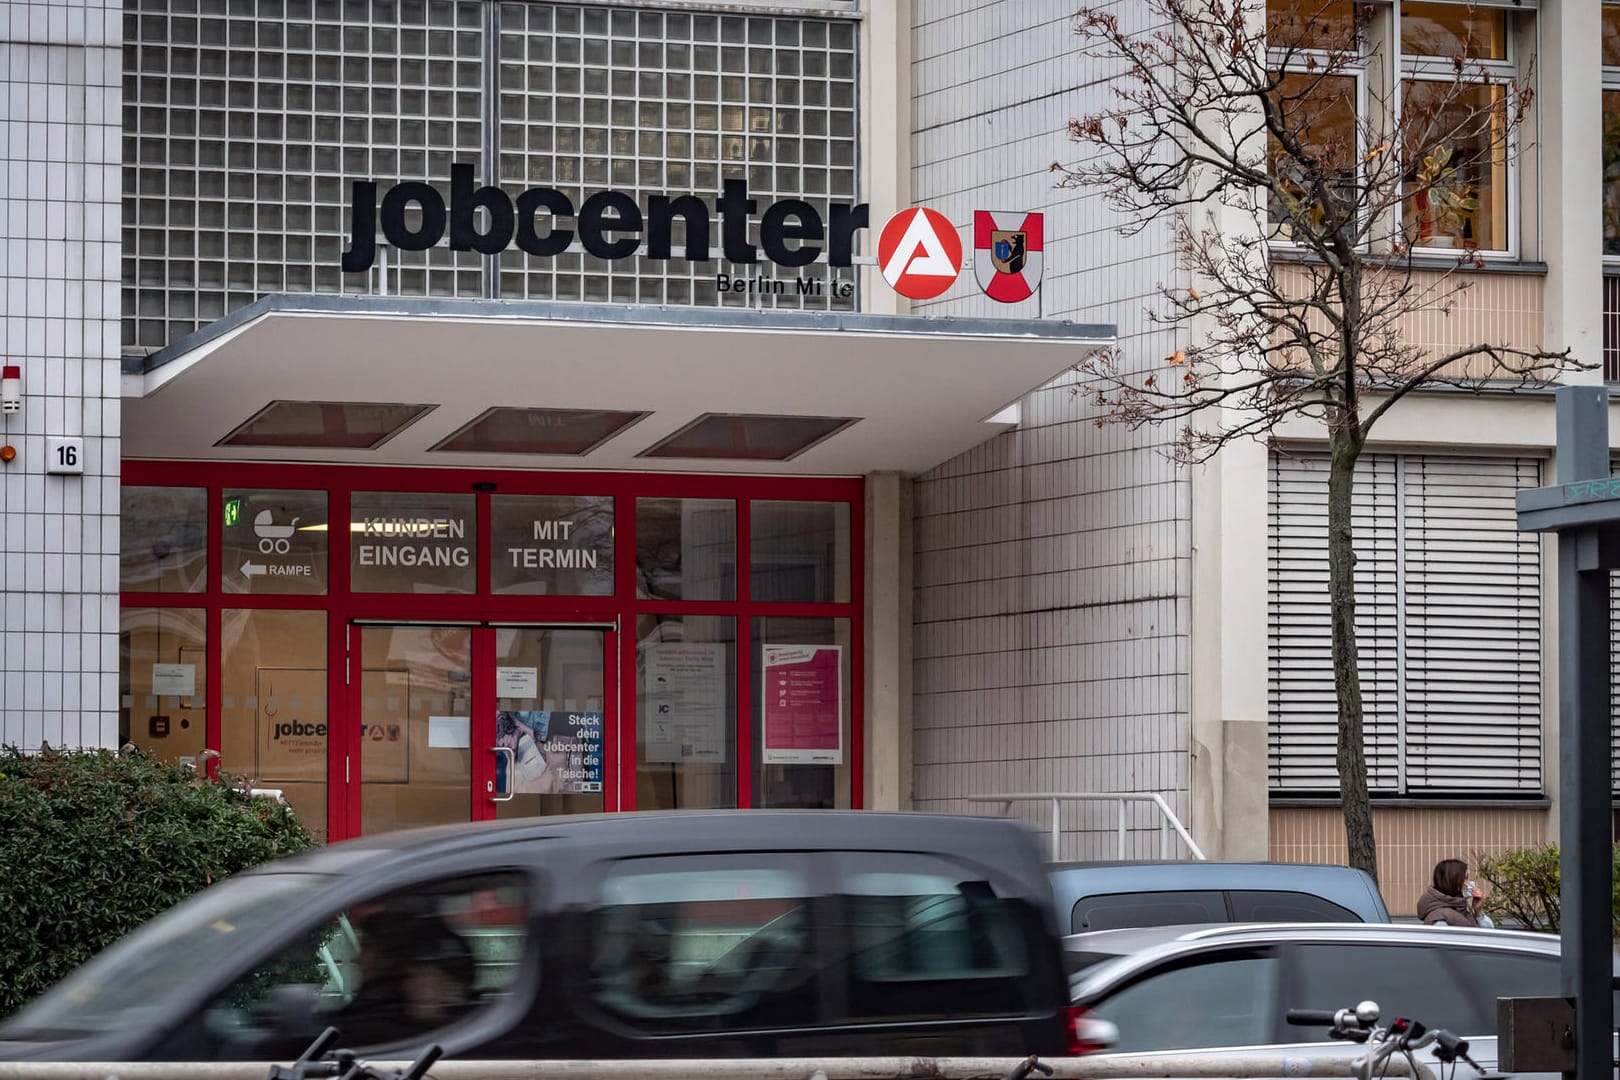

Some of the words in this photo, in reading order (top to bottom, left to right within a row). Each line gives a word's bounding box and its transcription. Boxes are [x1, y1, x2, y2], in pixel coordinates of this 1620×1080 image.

[341, 163, 869, 272] jobcenter
[716, 273, 785, 295] Berlin
[58, 446, 77, 465] 16
[362, 517, 466, 539] KUNDEN
[532, 520, 573, 541] MIT
[358, 545, 470, 568] EINGANG
[508, 547, 598, 570] TERMIN
[268, 565, 312, 577] RAMPE
[568, 714, 600, 726] Steck
[576, 729, 600, 739] dein
[543, 742, 600, 753] Jobcenter
[571, 755, 582, 766] in
[583, 755, 599, 766] die
[557, 768, 600, 780] Tasche!
